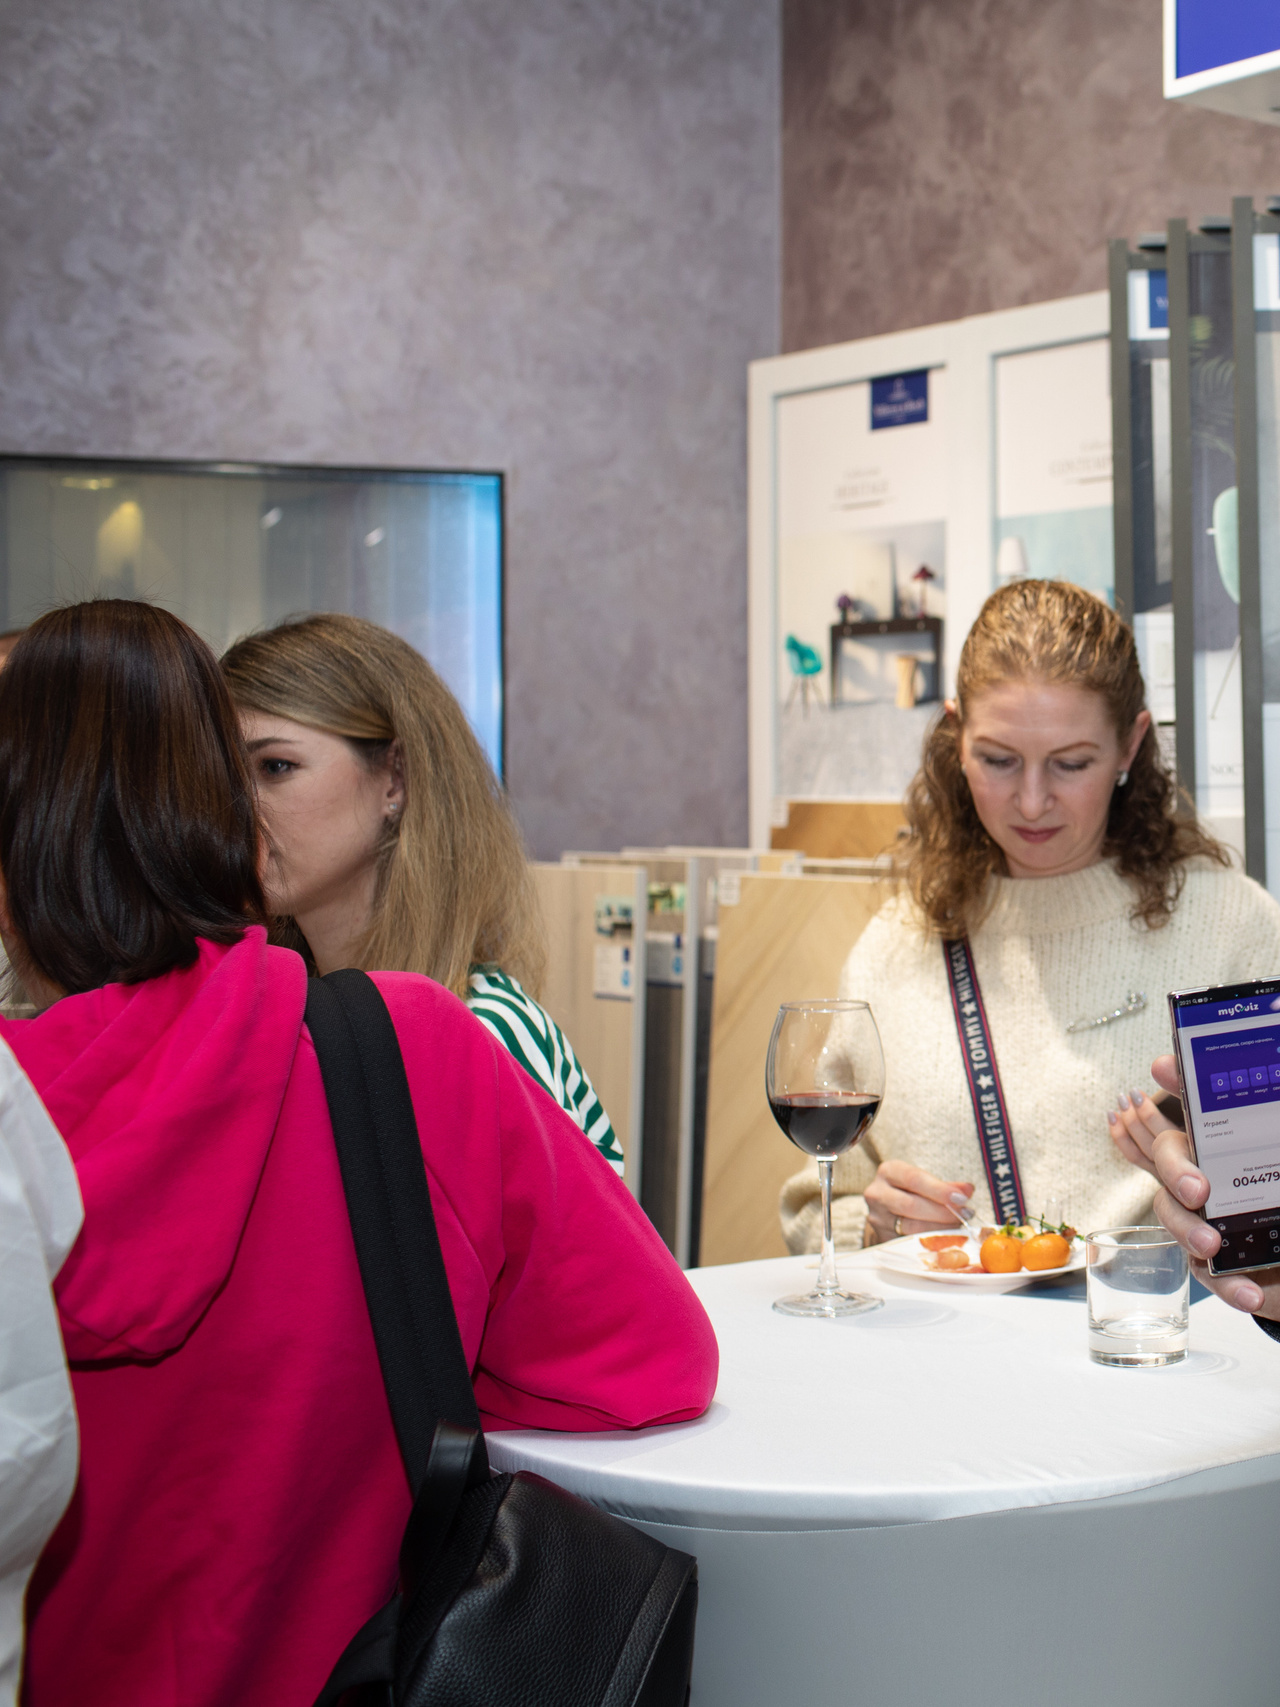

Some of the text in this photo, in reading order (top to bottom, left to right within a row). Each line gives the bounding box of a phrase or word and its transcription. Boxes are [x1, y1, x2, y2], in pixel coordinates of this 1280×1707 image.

[1218, 1002, 1259, 1016] myQuiz
[963, 1016, 989, 1071] TOMMY
[1217, 1069, 1280, 1087] 0 0 0 0
[980, 1091, 1007, 1161] HILFIGER
[1203, 1118, 1229, 1128] Играем!
[997, 1179, 1020, 1227] OMMY
